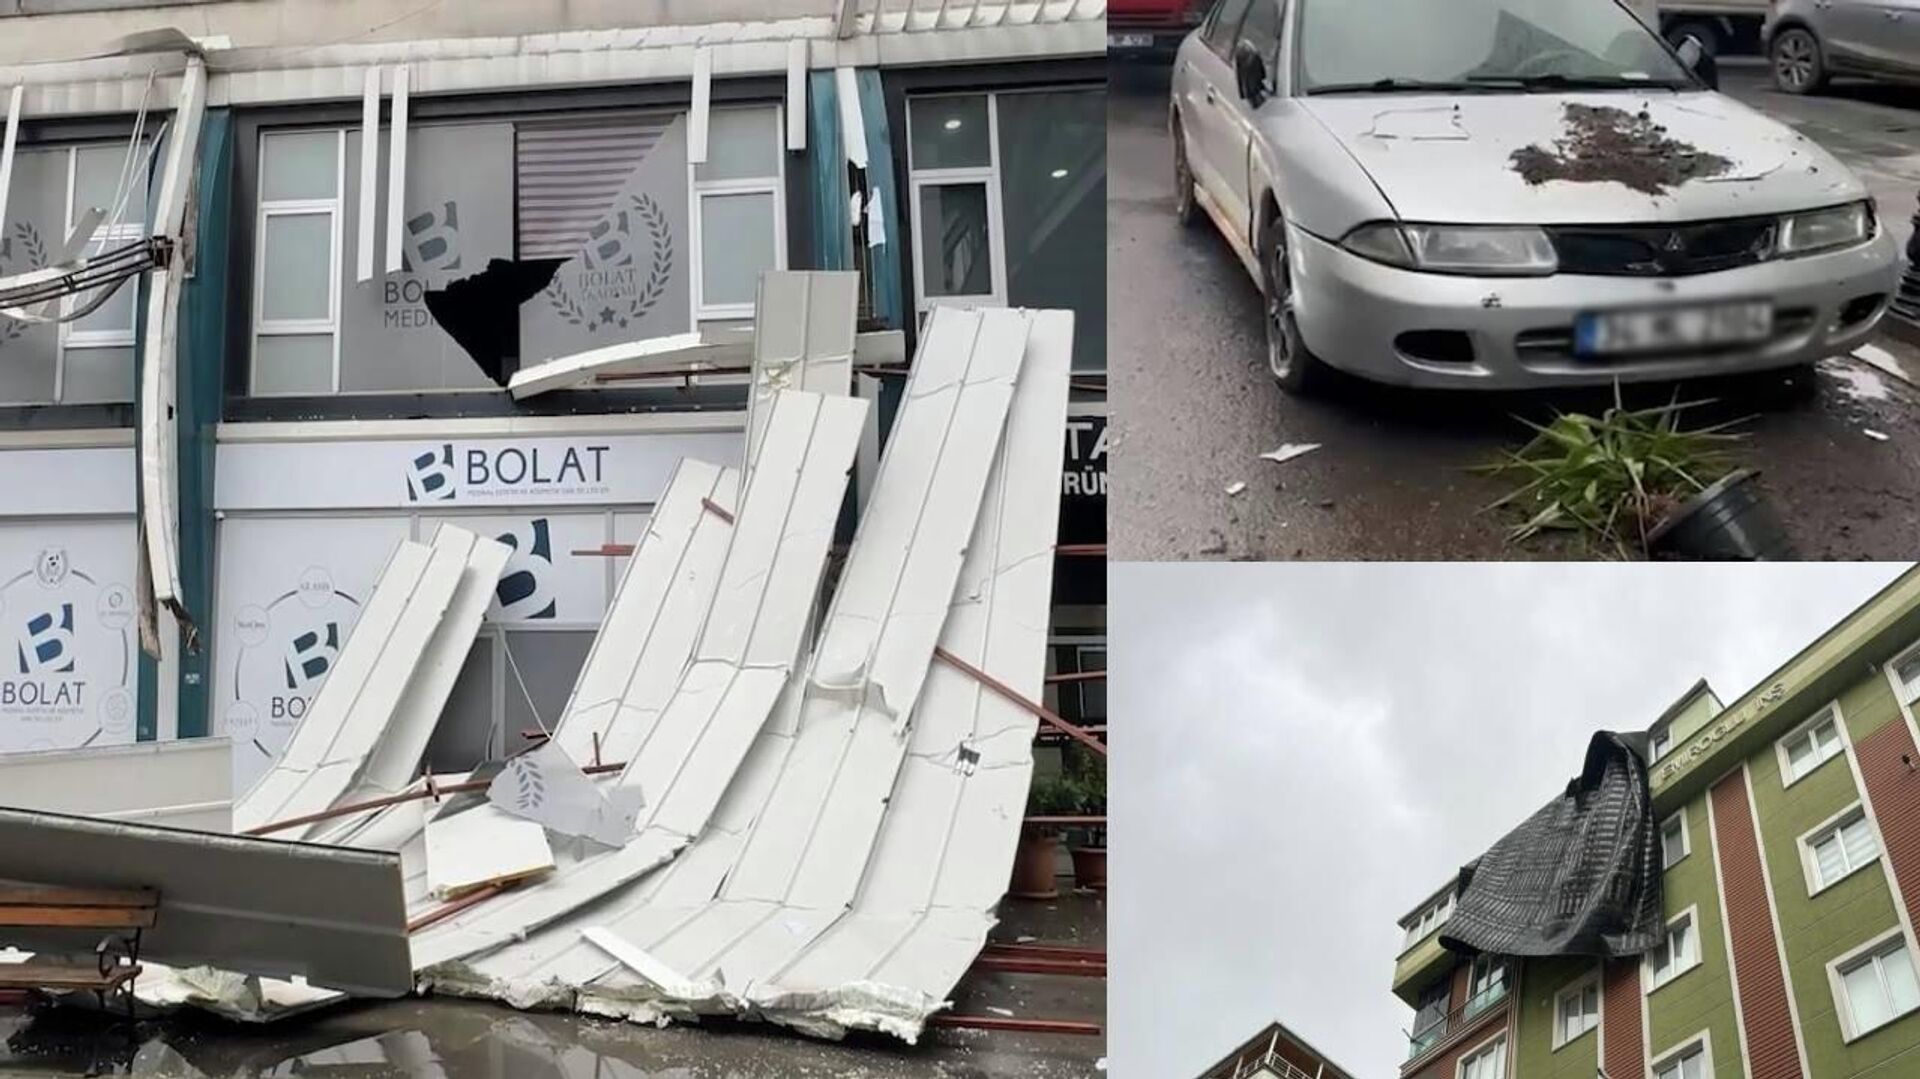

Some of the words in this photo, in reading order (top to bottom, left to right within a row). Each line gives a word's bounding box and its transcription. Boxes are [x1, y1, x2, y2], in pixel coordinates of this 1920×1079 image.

[579, 267, 636, 289] BOLAT
[467, 446, 610, 485] BOLAT
[2, 681, 86, 705] BOLAT
[271, 696, 312, 719] BO
